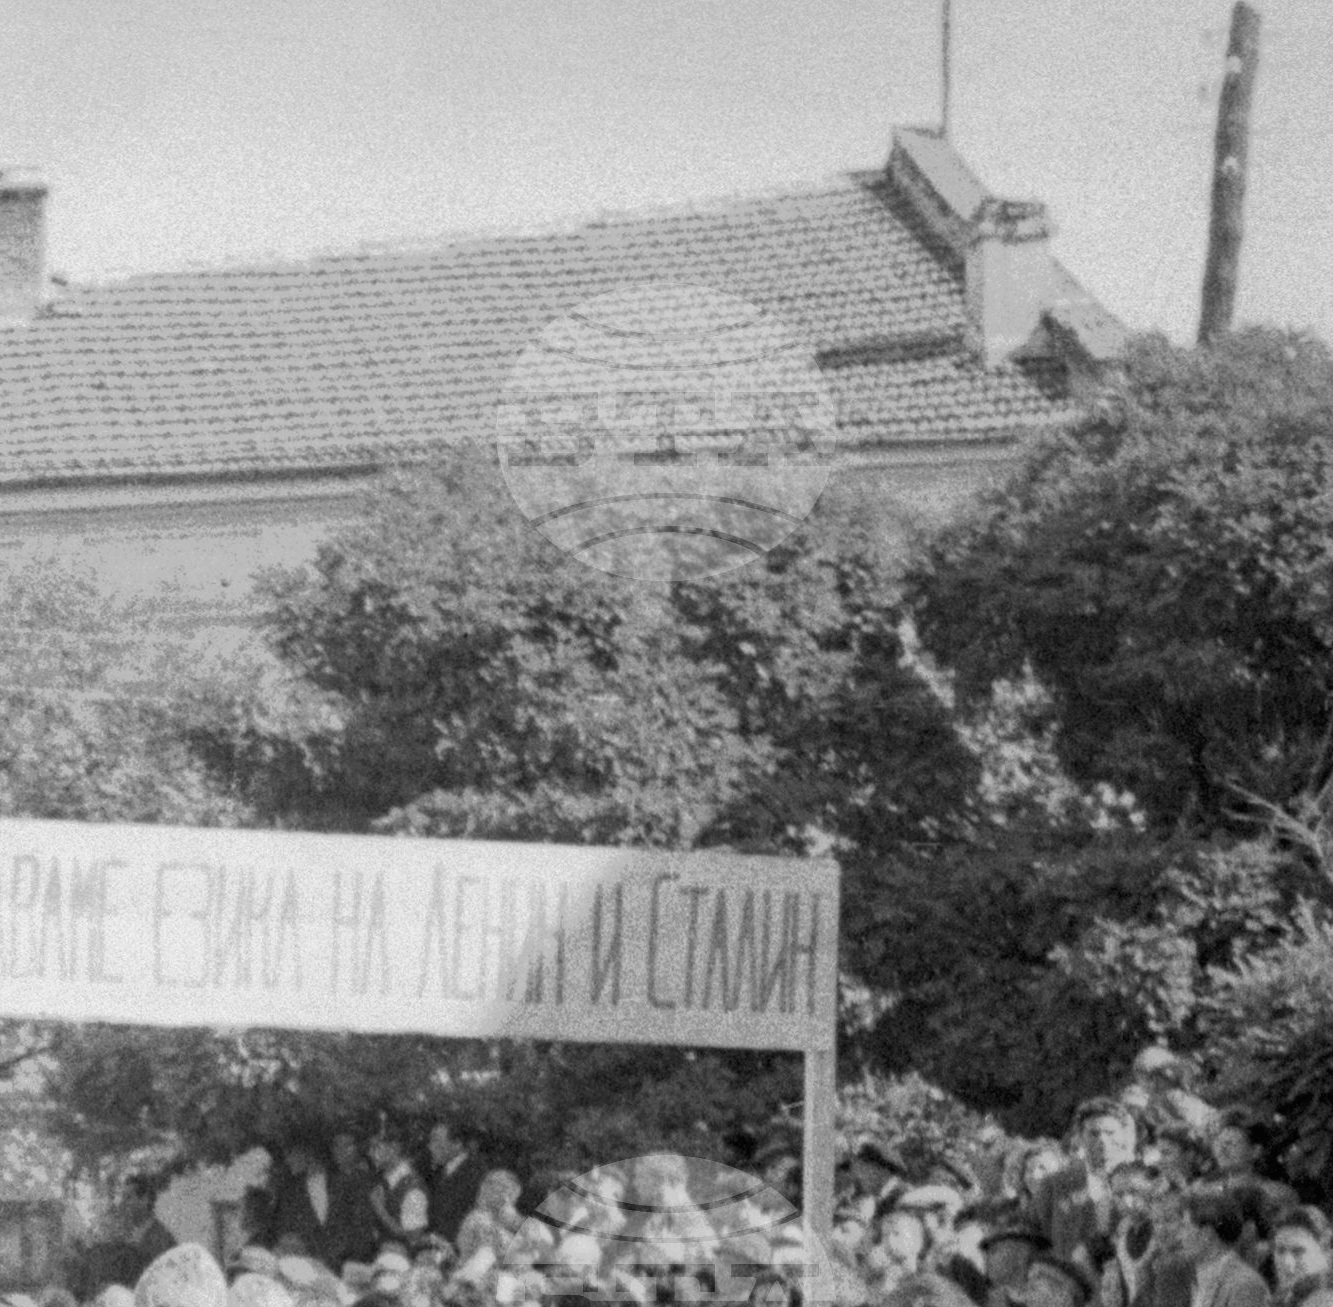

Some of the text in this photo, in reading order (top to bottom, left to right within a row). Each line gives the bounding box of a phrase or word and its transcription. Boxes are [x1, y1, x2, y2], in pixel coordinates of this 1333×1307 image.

[153, 860, 304, 989] ЕЗИКА
[332, 867, 392, 998] НА
[417, 862, 567, 1005] ЛЕНИН
[590, 881, 624, 1006] И
[647, 872, 821, 1017] СТАЛИН
